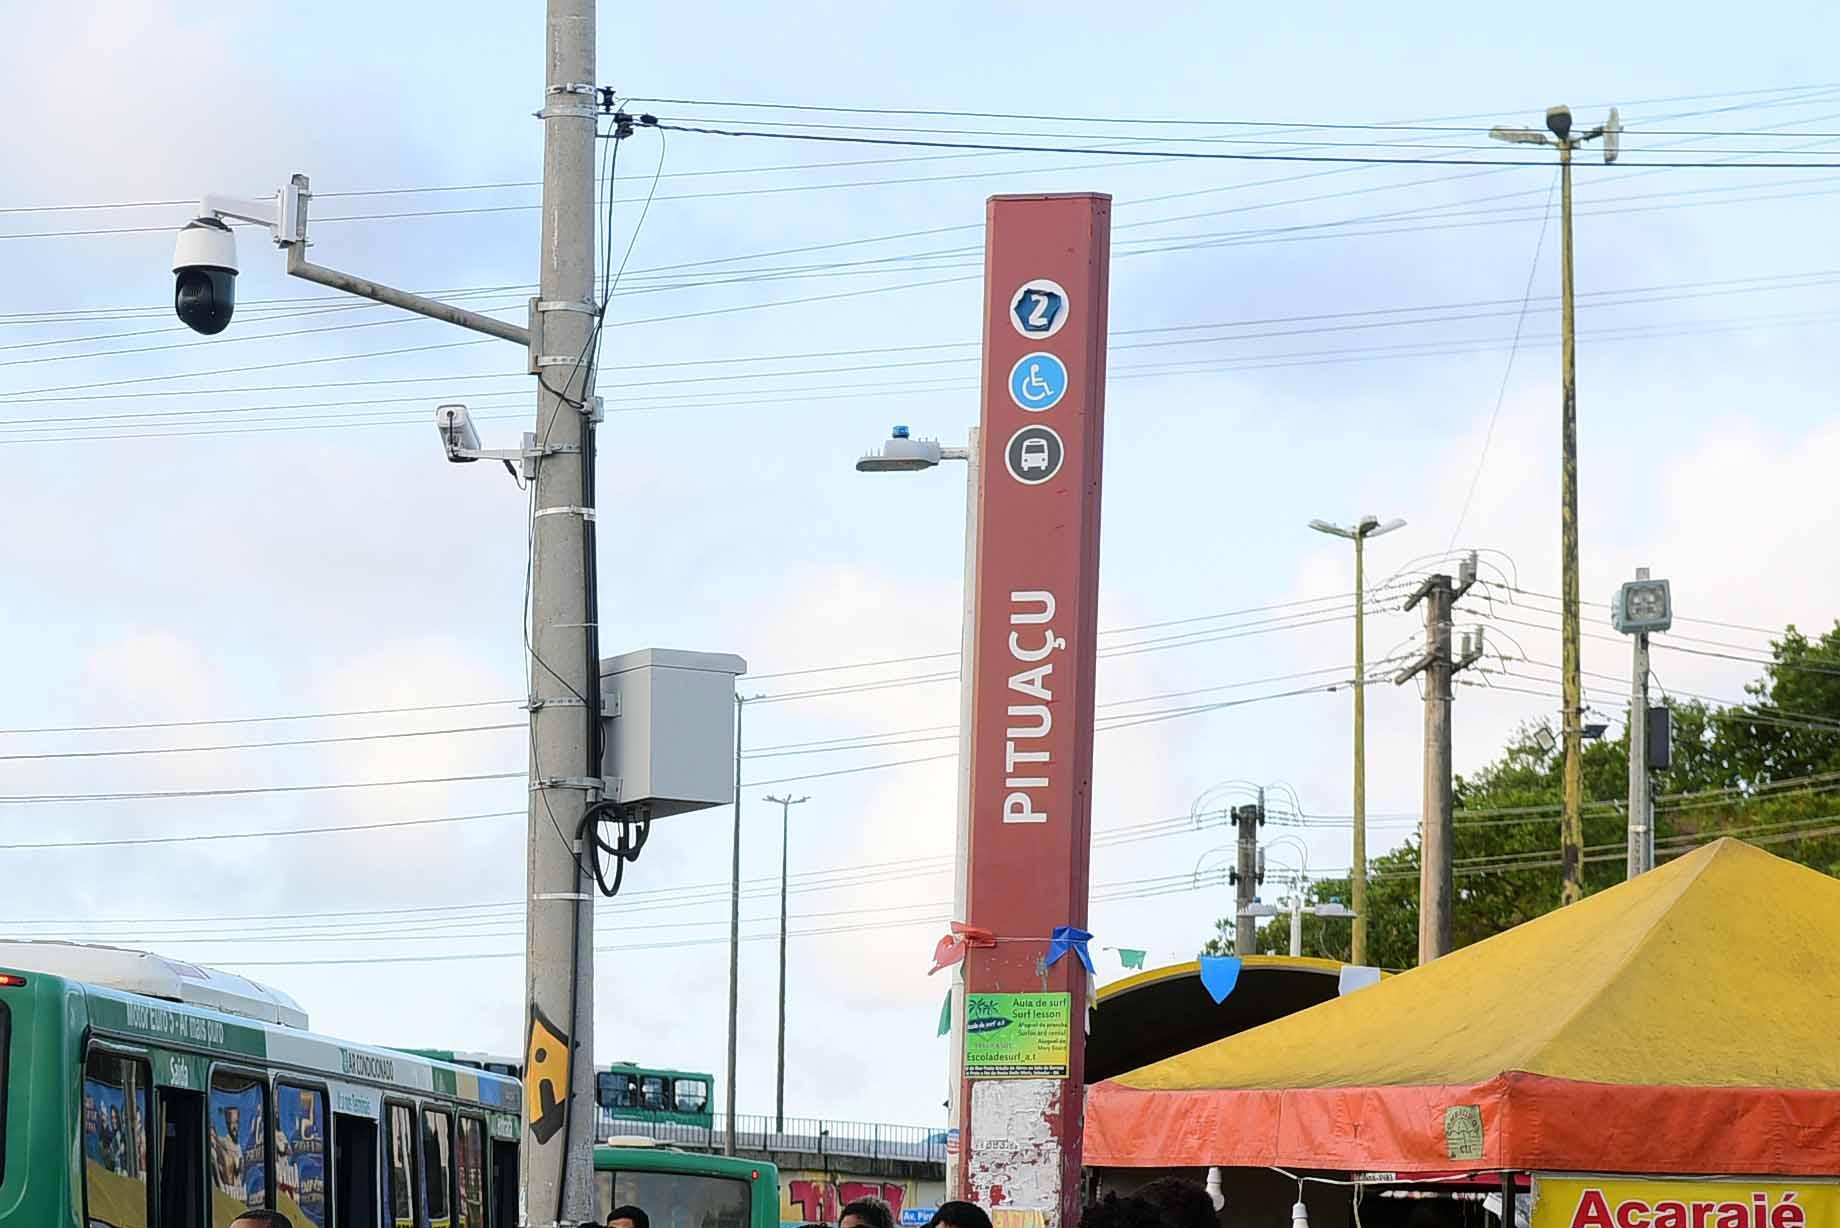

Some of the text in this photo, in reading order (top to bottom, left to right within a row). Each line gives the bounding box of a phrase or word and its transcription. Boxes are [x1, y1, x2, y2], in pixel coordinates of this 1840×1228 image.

[1028, 293, 1049, 327] 2
[1002, 590, 1066, 824] PITUAÇU
[1012, 998, 1067, 1008] Aula de surf
[1012, 1009, 1062, 1019] Surf lesson
